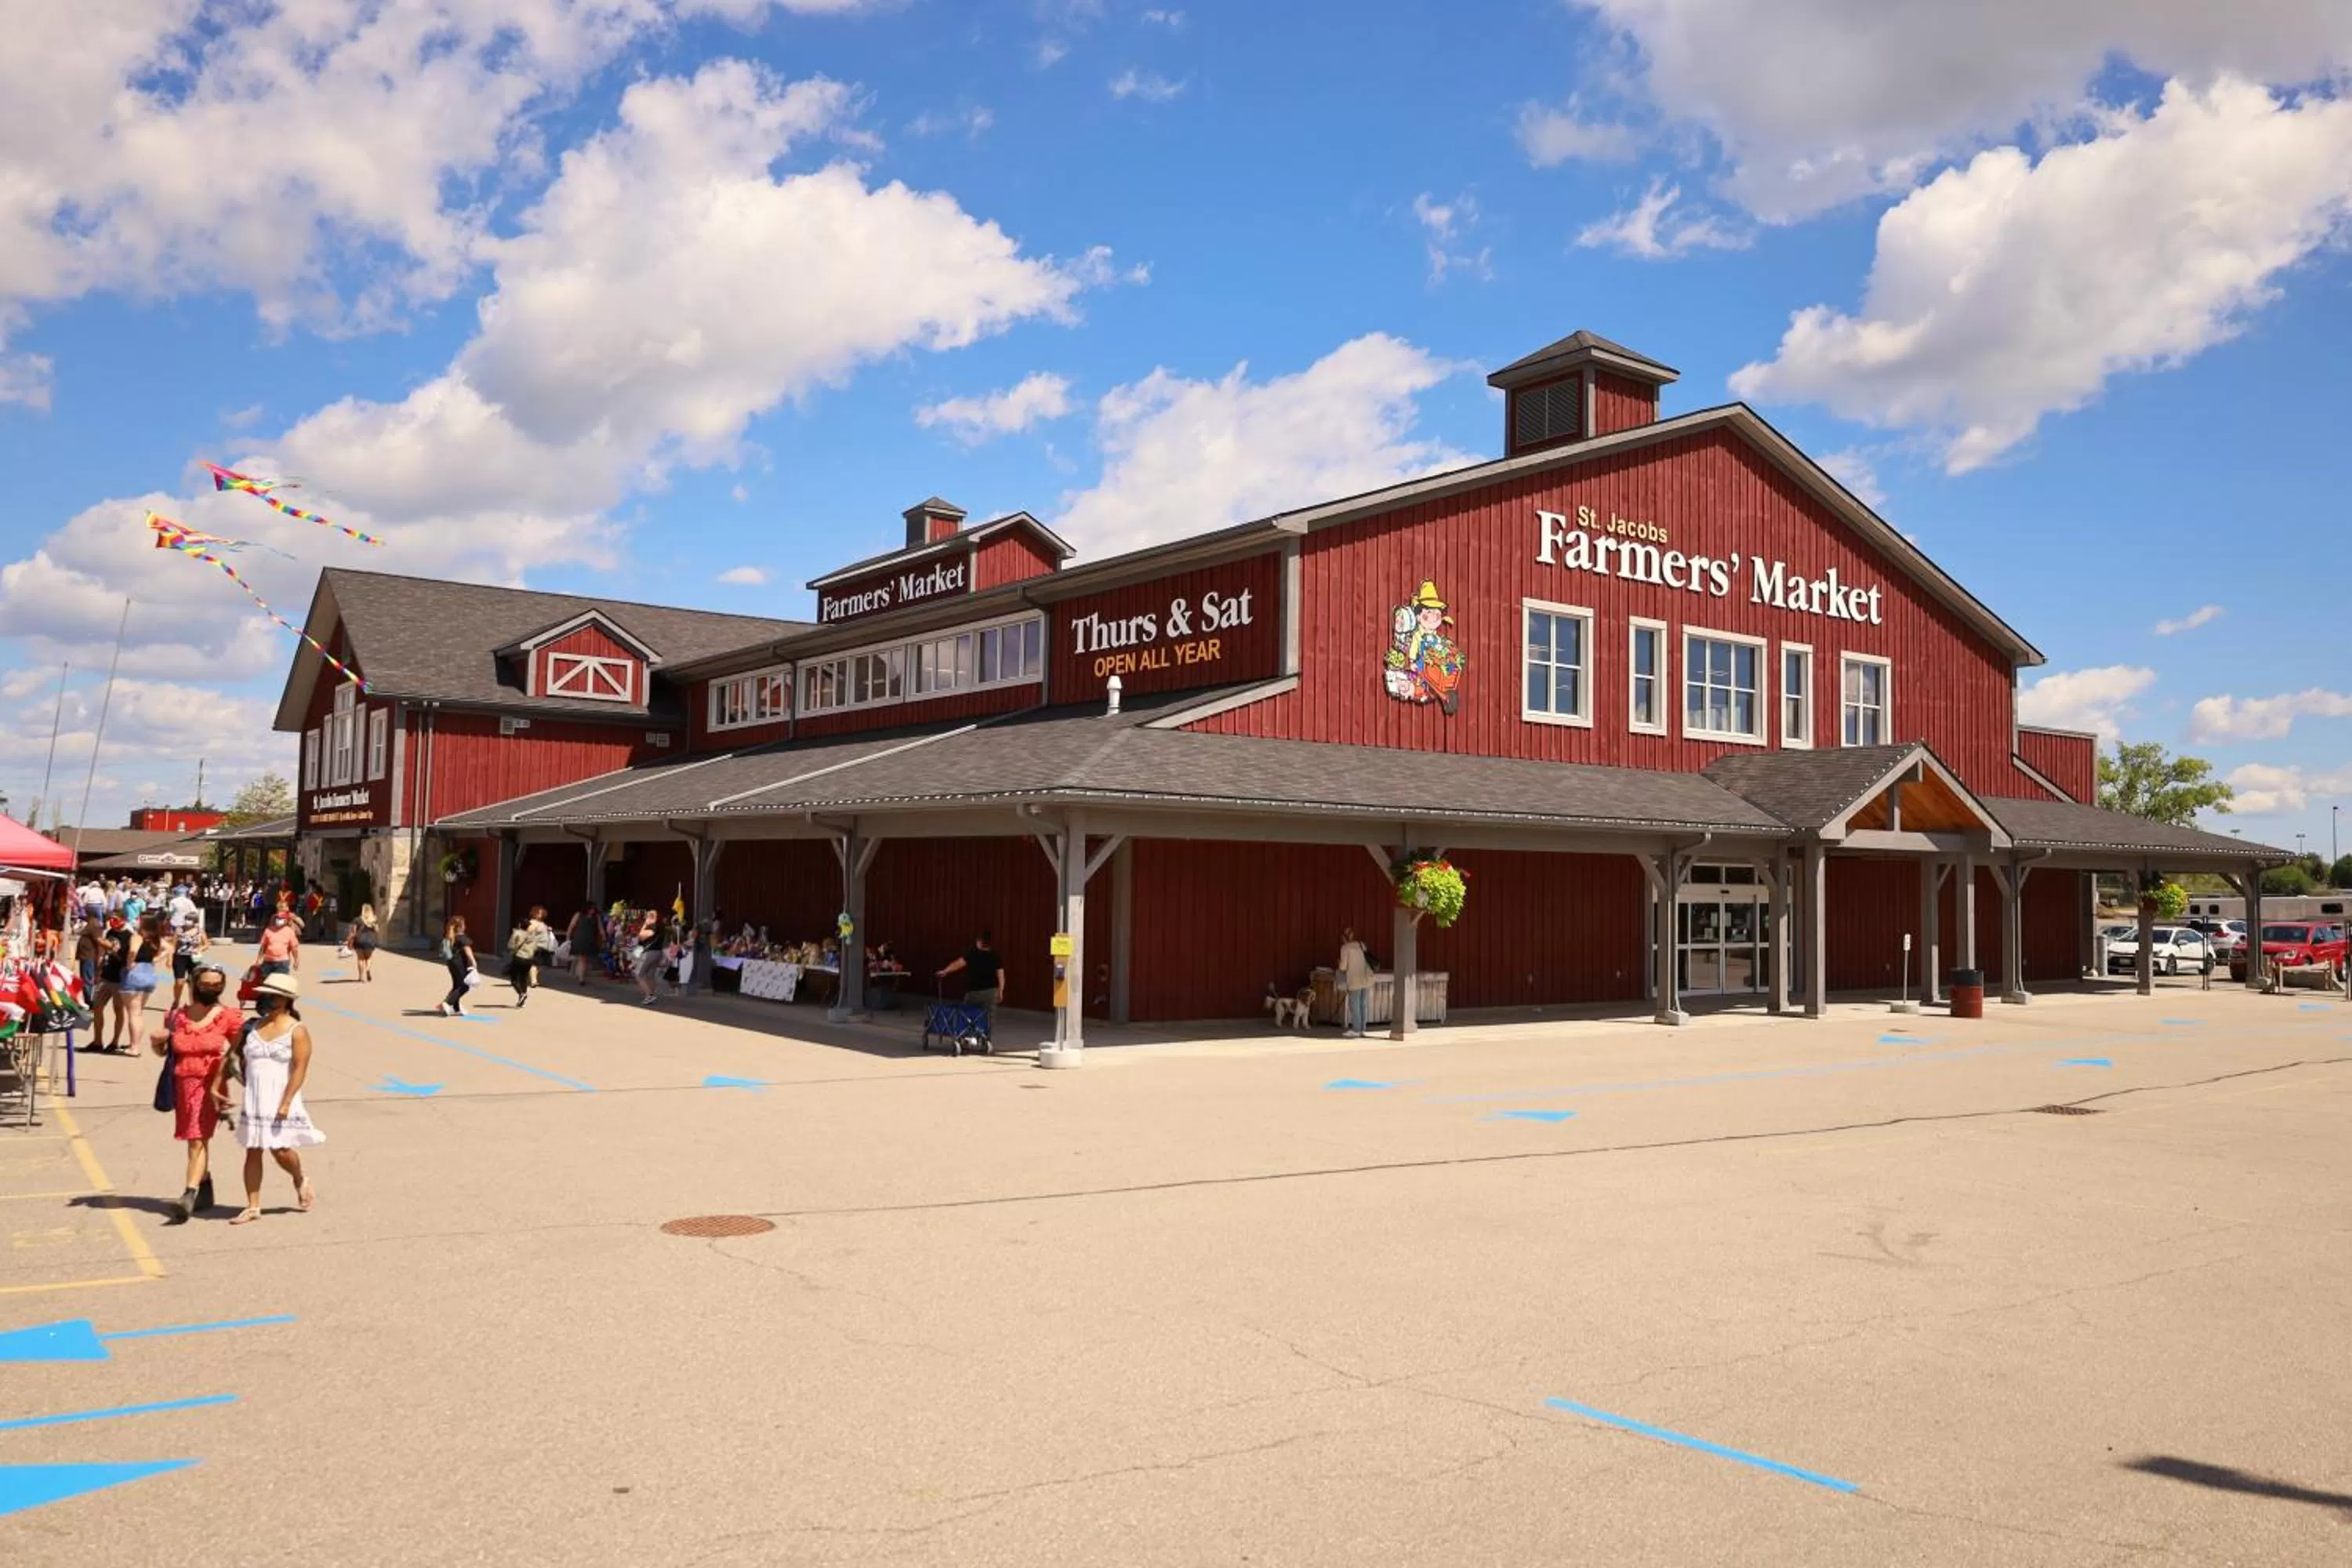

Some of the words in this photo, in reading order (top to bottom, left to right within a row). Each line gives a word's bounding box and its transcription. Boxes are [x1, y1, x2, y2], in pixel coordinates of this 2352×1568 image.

[1578, 506, 1599, 528] St.
[1607, 513, 1668, 543] Jacobs
[822, 581, 895, 622] Farmers'
[898, 562, 965, 602] Market
[1536, 510, 1740, 597] Farmers'
[1750, 556, 1882, 625] Market
[1071, 612, 1157, 654] Thurs
[1167, 597, 1192, 638] &
[1202, 588, 1254, 633] Sat
[1094, 652, 1136, 677] OPEN
[1140, 648, 1171, 671] ALL
[1174, 639, 1221, 665] YEAR
